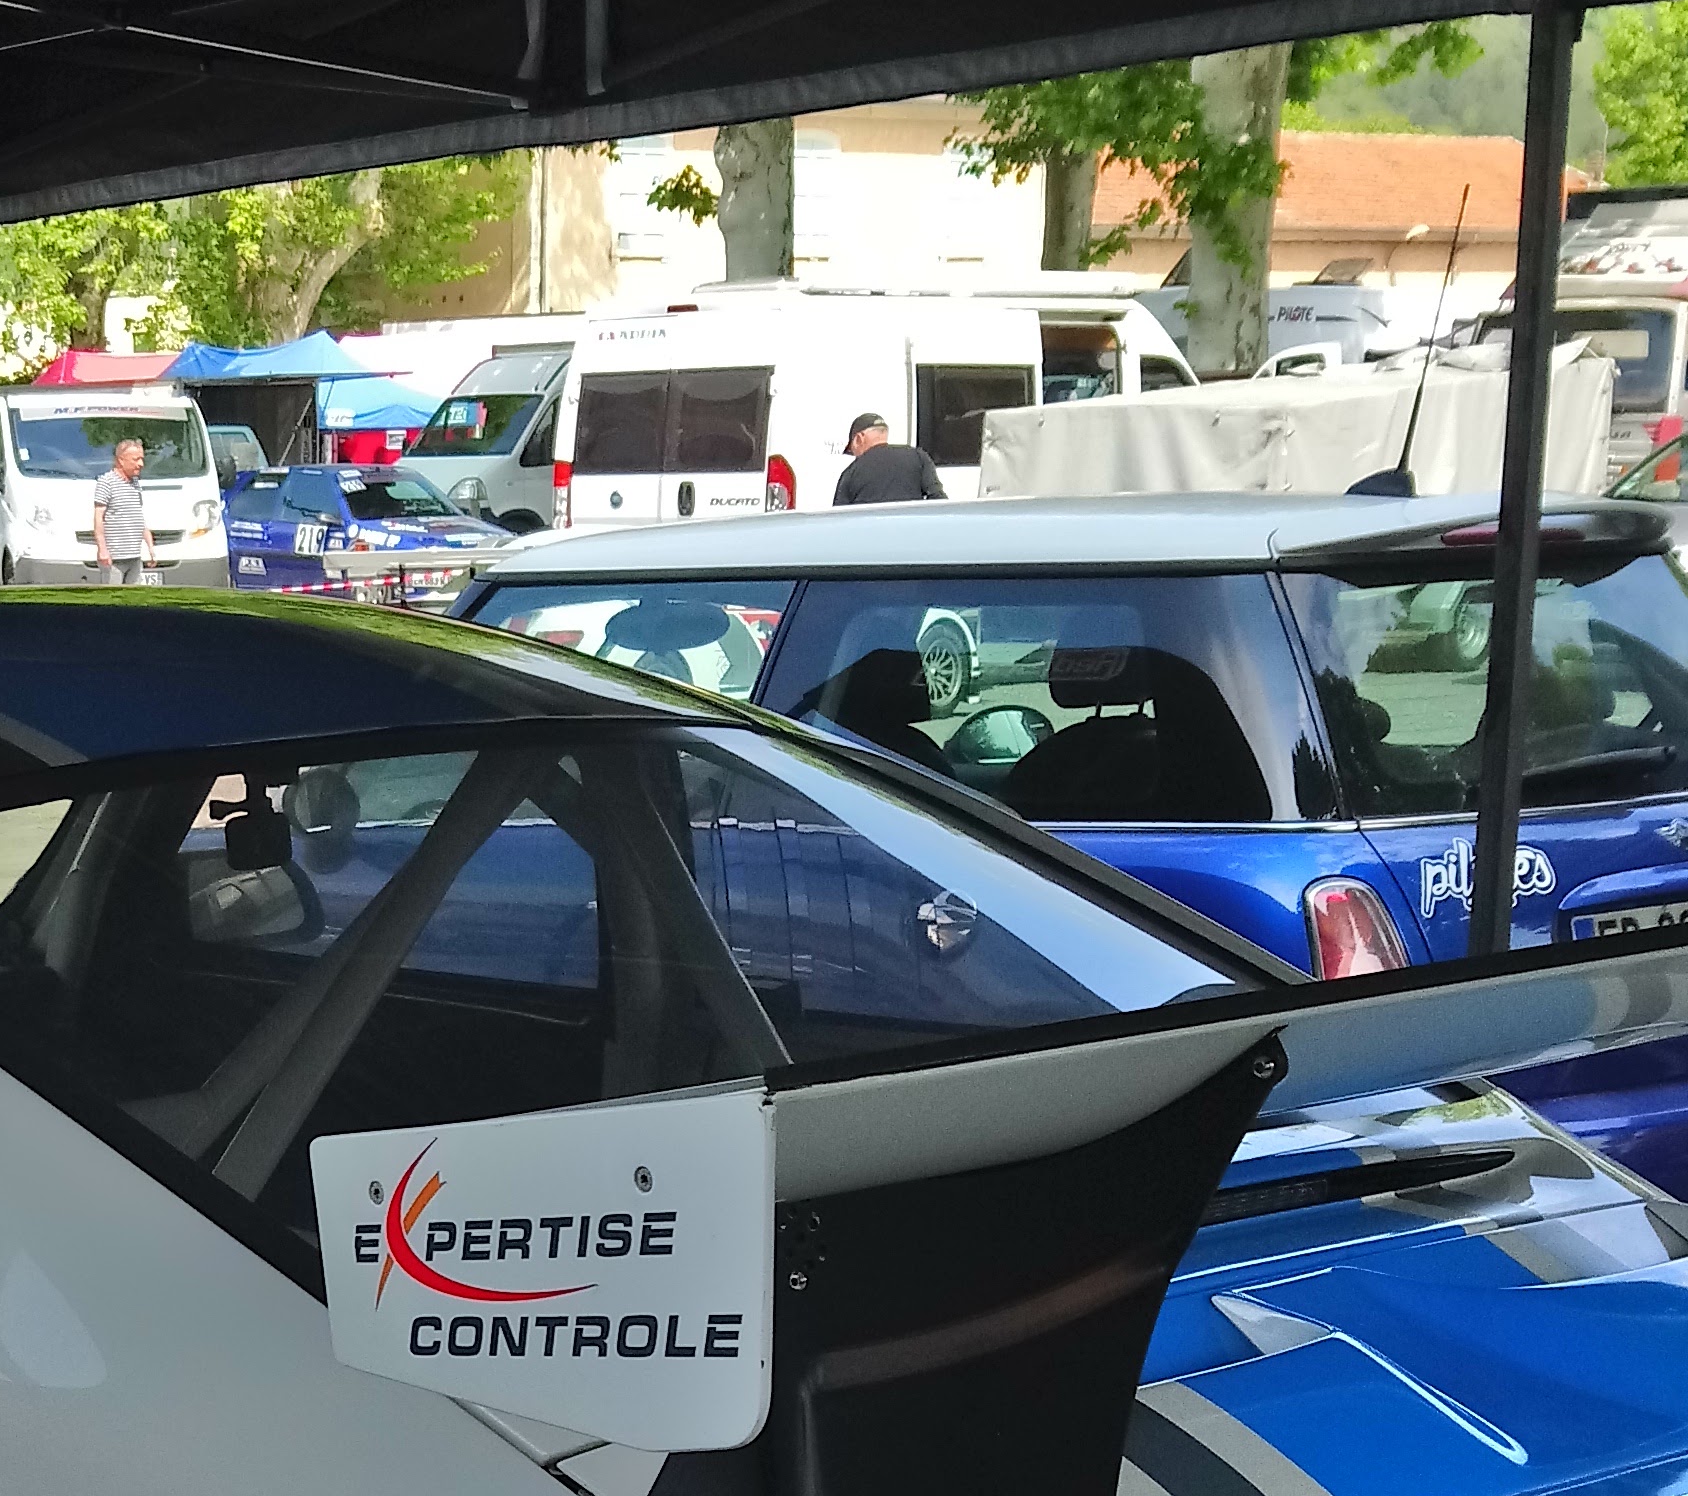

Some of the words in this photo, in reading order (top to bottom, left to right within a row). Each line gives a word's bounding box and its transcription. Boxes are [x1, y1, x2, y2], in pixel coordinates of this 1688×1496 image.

[1276, 306, 1314, 322] PILOTE
[709, 497, 760, 507] DUCATO
[297, 526, 325, 554] 219
[1422, 838, 1555, 916] piles
[354, 1179, 679, 1276] EXPERTISE
[408, 1313, 744, 1359] CONTROLE
